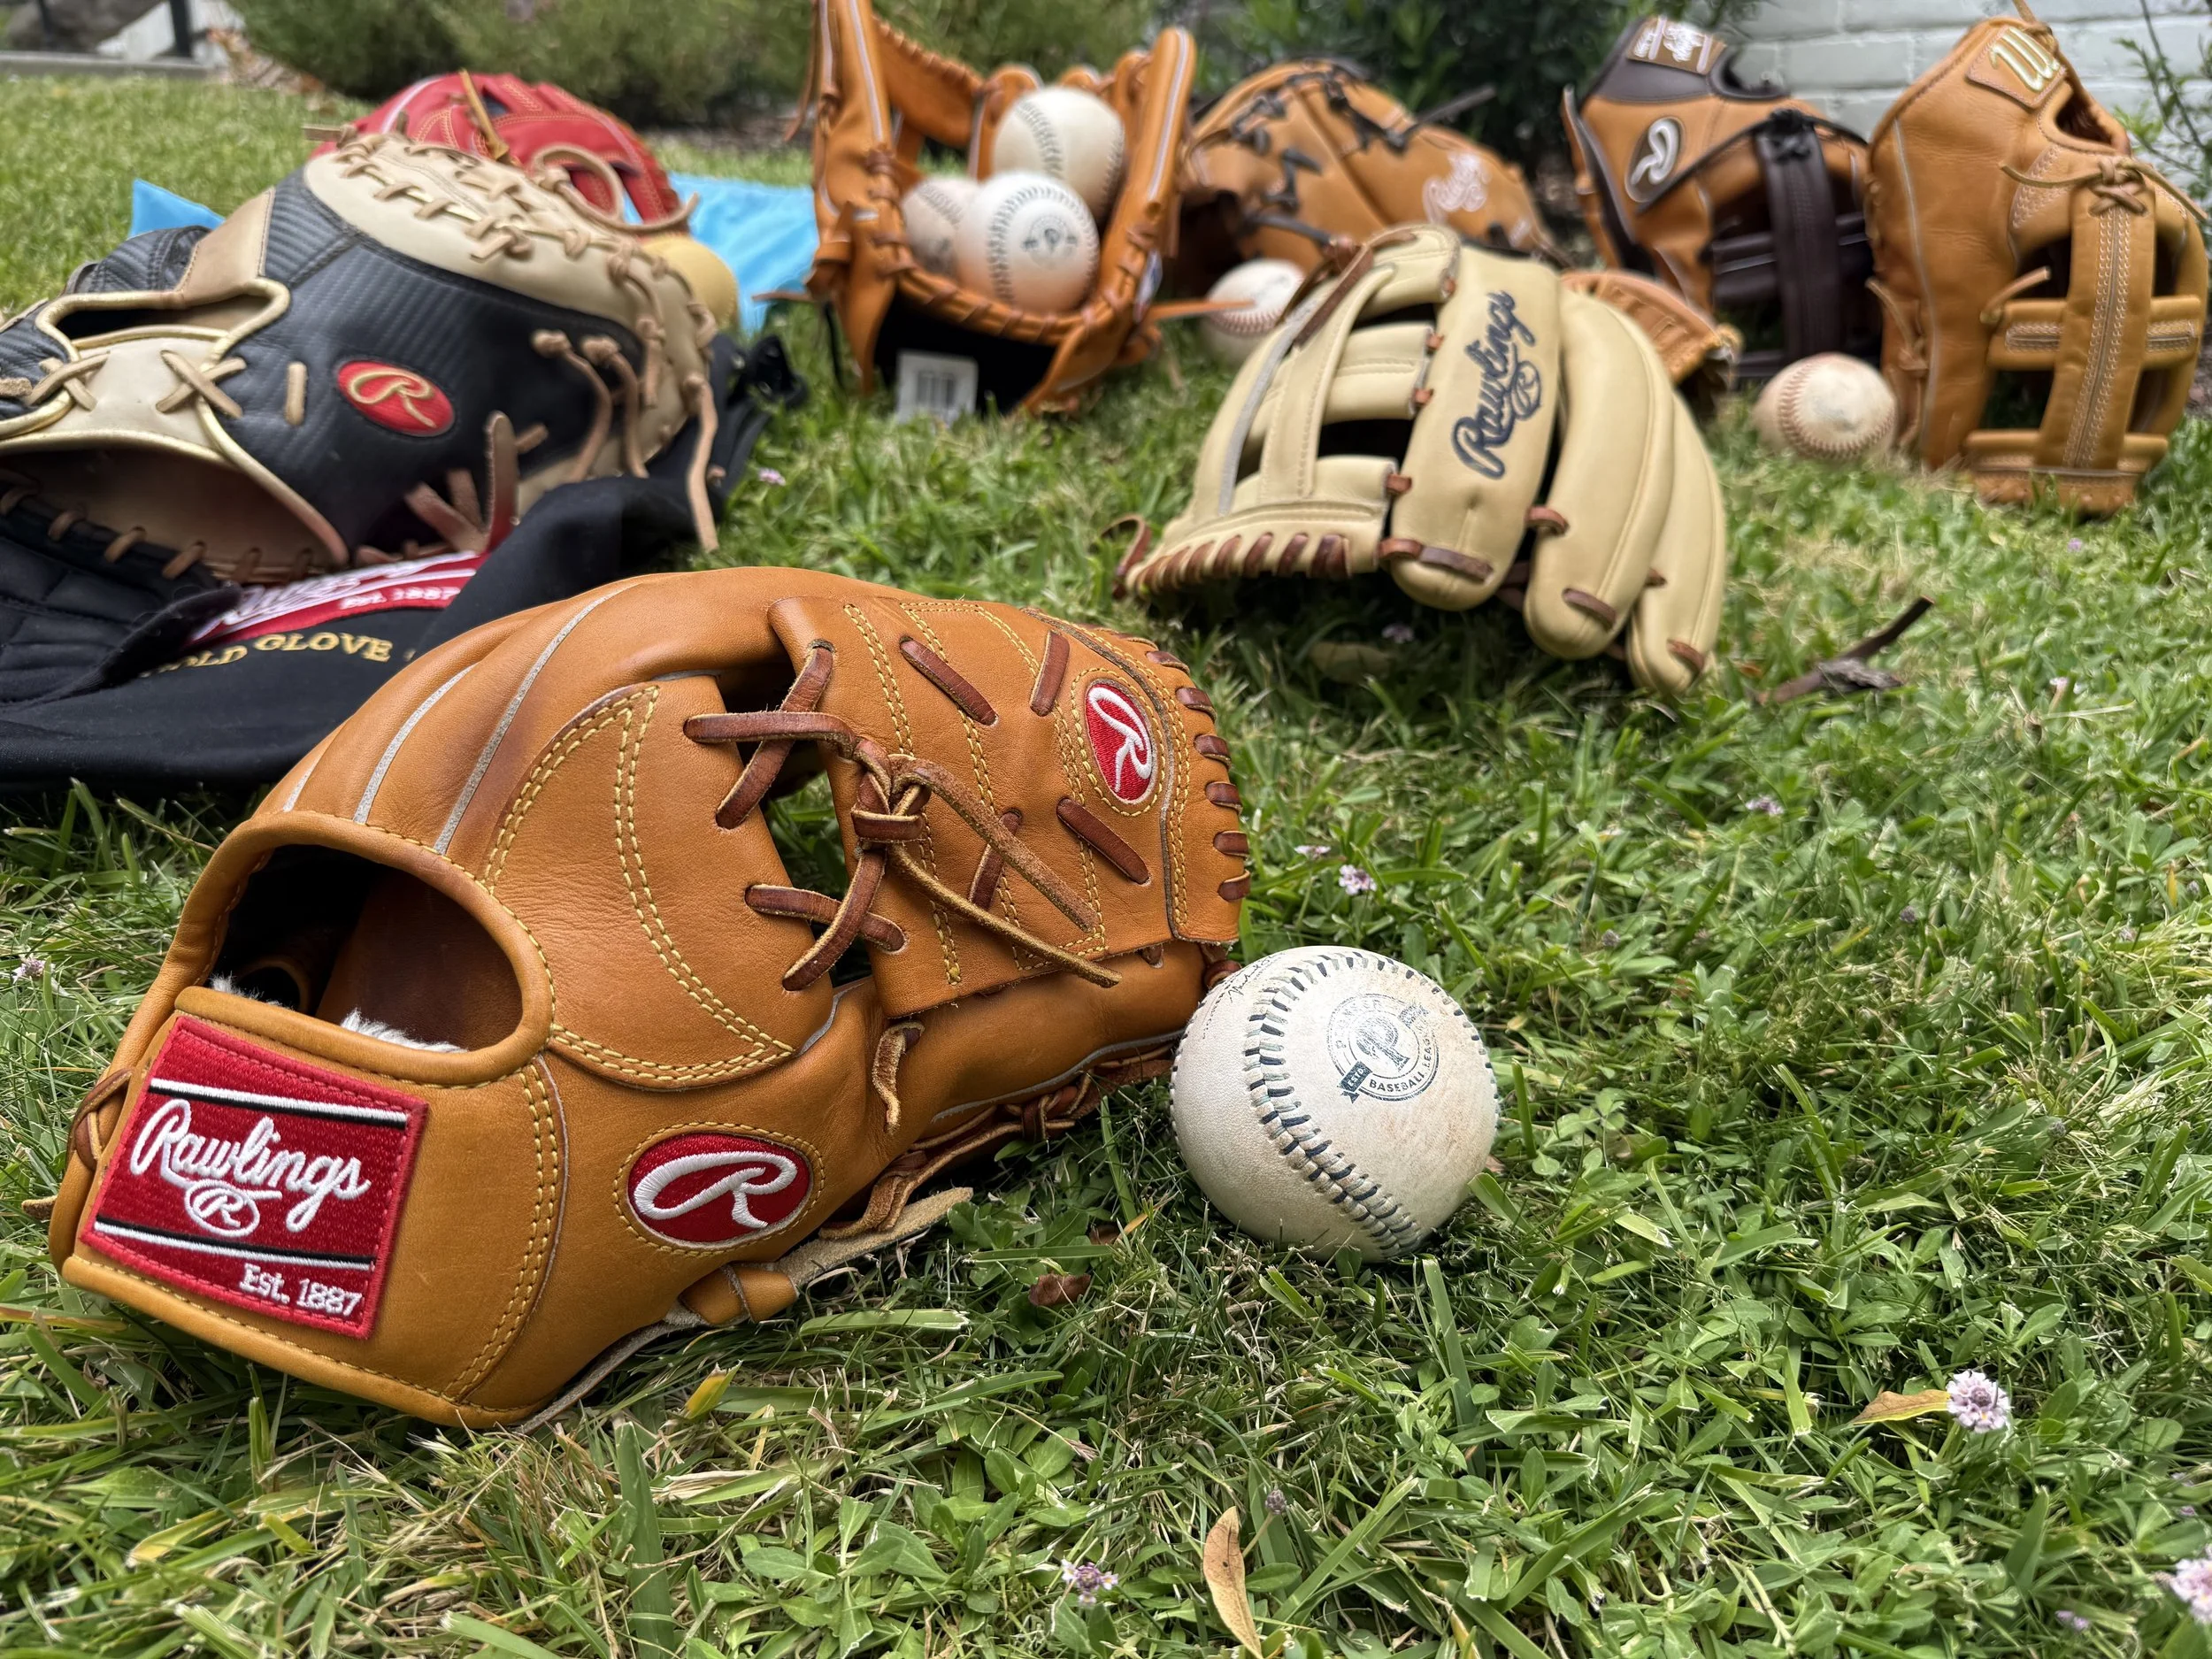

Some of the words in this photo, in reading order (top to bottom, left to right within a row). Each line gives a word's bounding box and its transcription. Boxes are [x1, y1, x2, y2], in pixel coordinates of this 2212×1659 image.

[349, 365, 438, 428] R
[1451, 290, 1536, 480] Rawlings
[253, 632, 395, 663] GLOVE
[1088, 687, 1152, 793] R
[1369, 1071, 1425, 1093] BASEBALL
[129, 1099, 372, 1233] Rawlings
[634, 1150, 797, 1228] R
[239, 1263, 291, 1305] Est.
[296, 1277, 365, 1317] 1887
